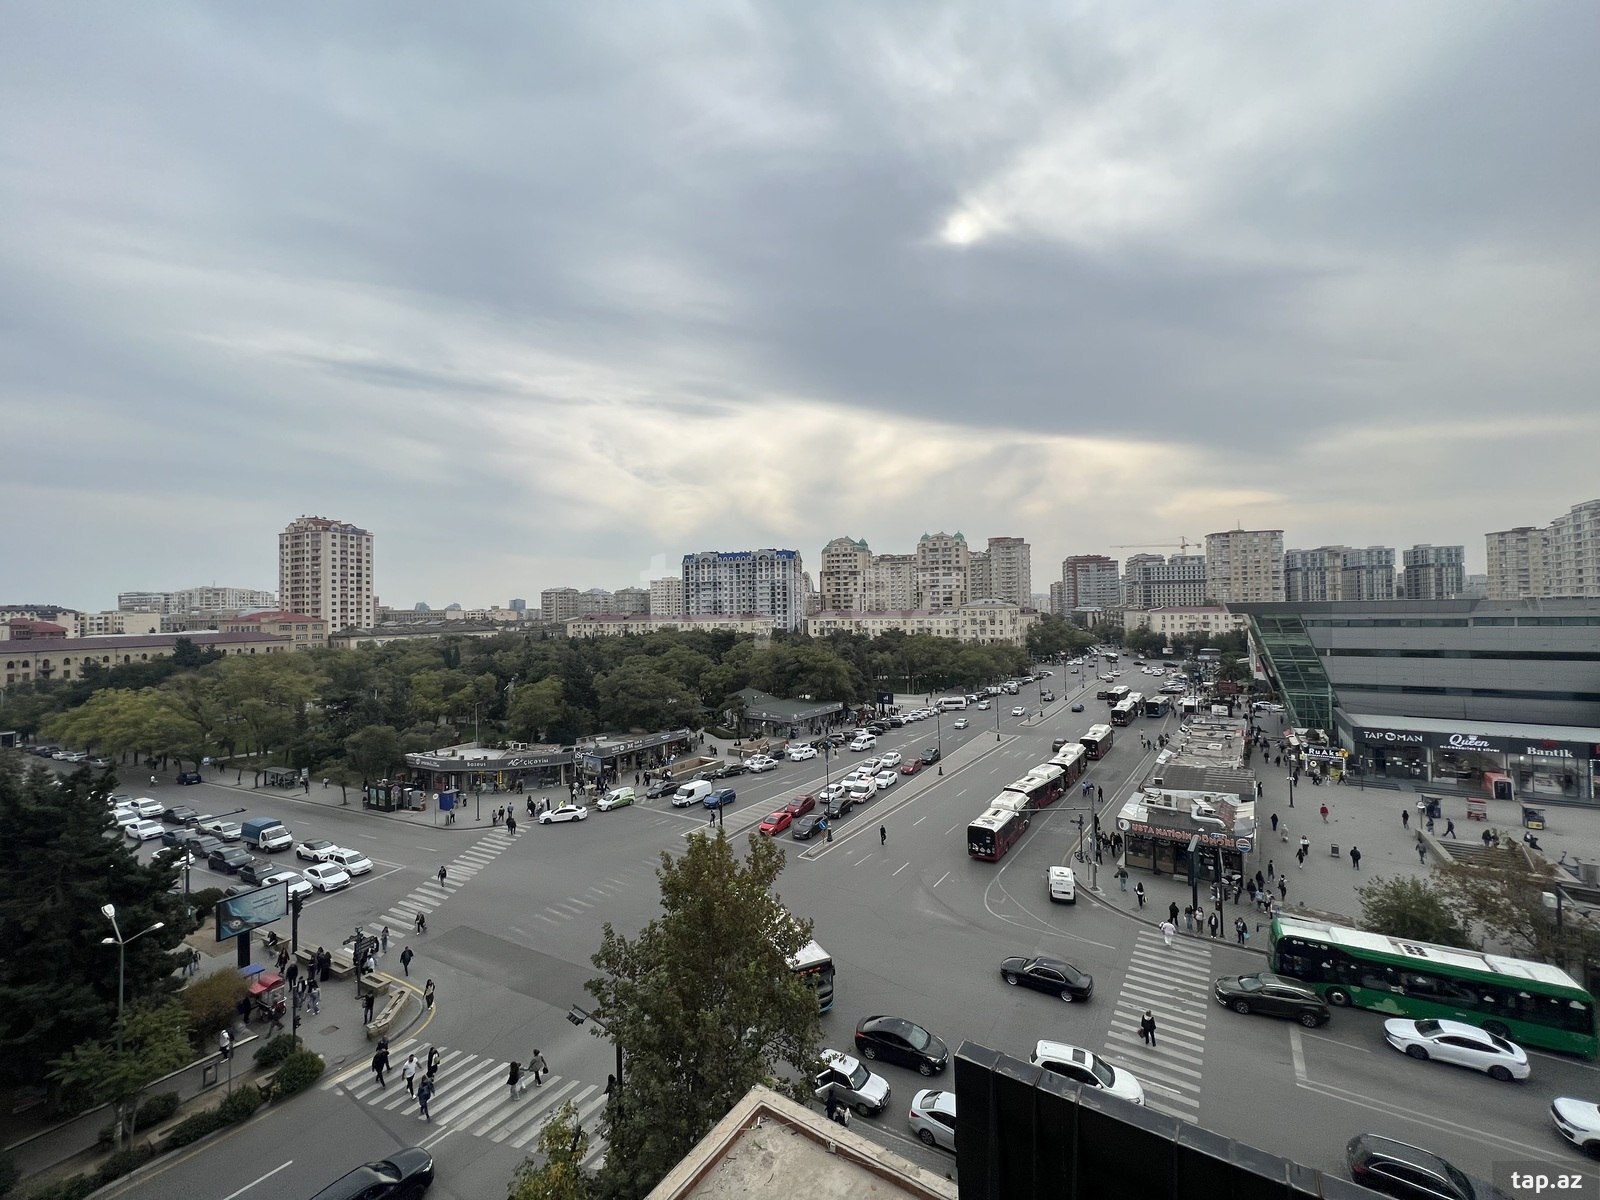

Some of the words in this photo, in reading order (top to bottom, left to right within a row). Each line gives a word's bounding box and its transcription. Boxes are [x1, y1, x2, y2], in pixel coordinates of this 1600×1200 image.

[1449, 734, 1490, 747] Queen
[1527, 746, 1573, 758] Bantik
[1131, 823, 1155, 834] USTA
